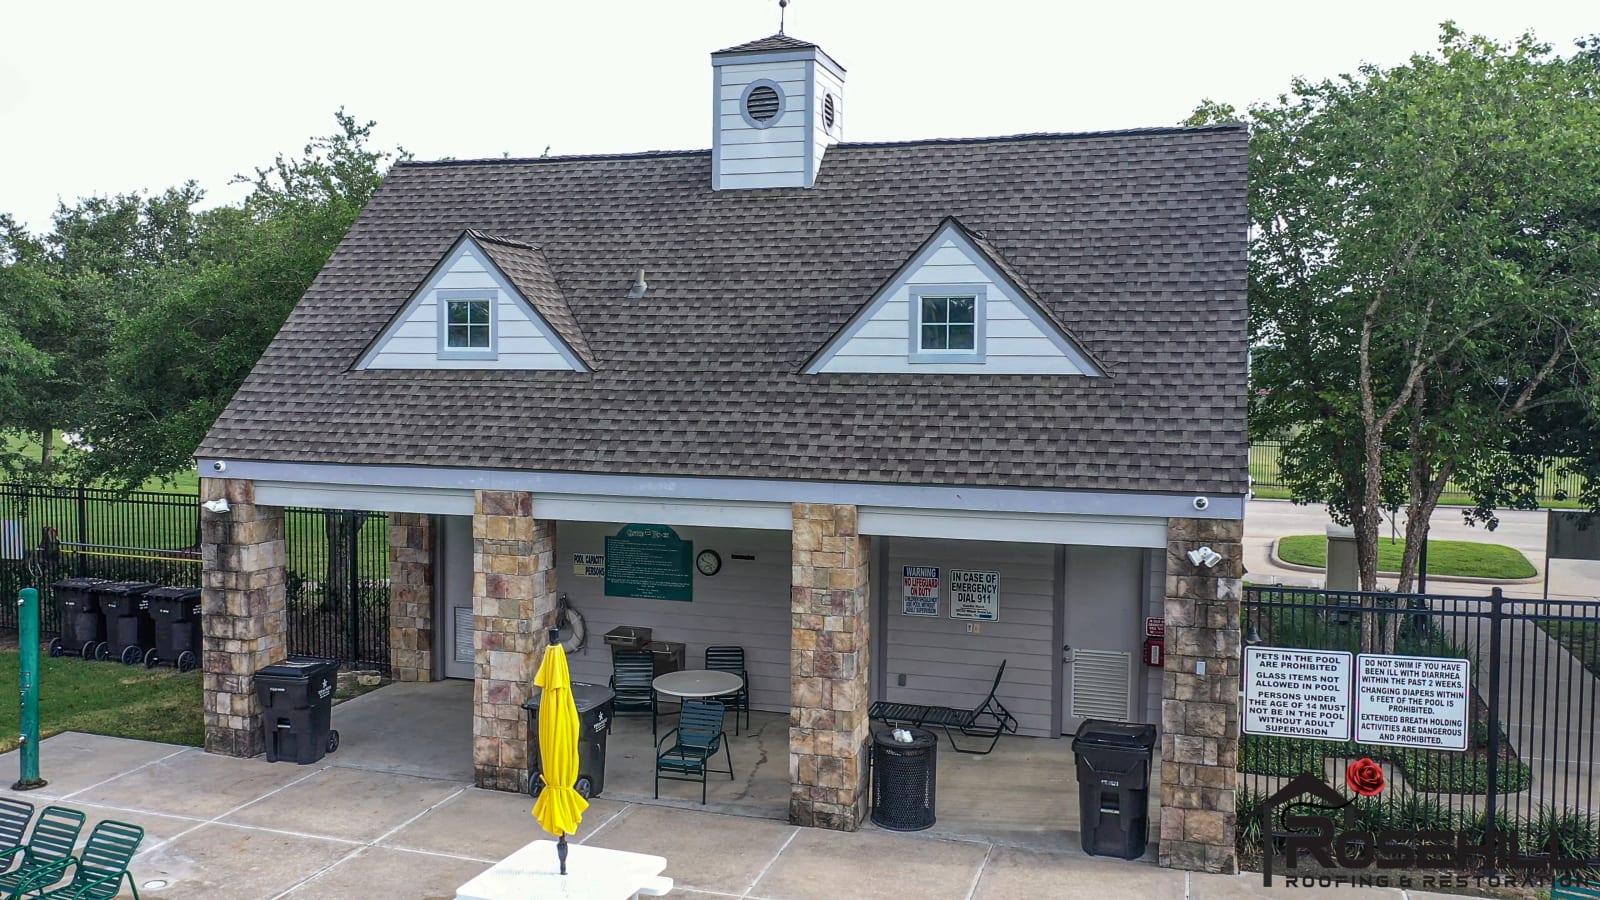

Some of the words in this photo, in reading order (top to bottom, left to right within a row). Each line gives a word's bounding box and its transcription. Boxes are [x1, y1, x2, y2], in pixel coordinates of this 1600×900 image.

[907, 568, 936, 577] WARNING
[953, 572, 960, 581] IN
[964, 573, 983, 582] CASE
[986, 575, 996, 583] OF
[904, 578, 911, 586] NO
[912, 579, 938, 587] LIFEGUARD
[918, 588, 931, 596] DUTY
[952, 583, 997, 594] EMERGENCY
[958, 593, 975, 602] DIAL
[978, 594, 990, 604] 911
[1316, 656, 1340, 664] POOL
[1281, 662, 1337, 671] PROHIBITED
[1422, 671, 1459, 679] DIARRHEA
[1256, 680, 1299, 688] ALLOWED
[1362, 676, 1388, 684] WITHIN
[1258, 691, 1301, 700] PERSONS
[1361, 686, 1400, 695] CHANGING
[1403, 689, 1434, 697] DIAPERS
[1437, 691, 1464, 699] WITHIN
[1320, 704, 1346, 712] MUST
[1389, 705, 1434, 714] PROHIBITED.
[1258, 716, 1302, 725] WITHOUT
[1320, 712, 1344, 720] POOL
[1362, 714, 1398, 722] EXTENDED
[1400, 716, 1427, 724] BREATH
[1430, 719, 1462, 727] HOLDING
[1266, 725, 1328, 735] SUPERVISION
[1361, 723, 1400, 731] ACTIVITIES
[1418, 727, 1462, 736] DANGEROUS
[1397, 735, 1443, 744] PROHIBITED.
